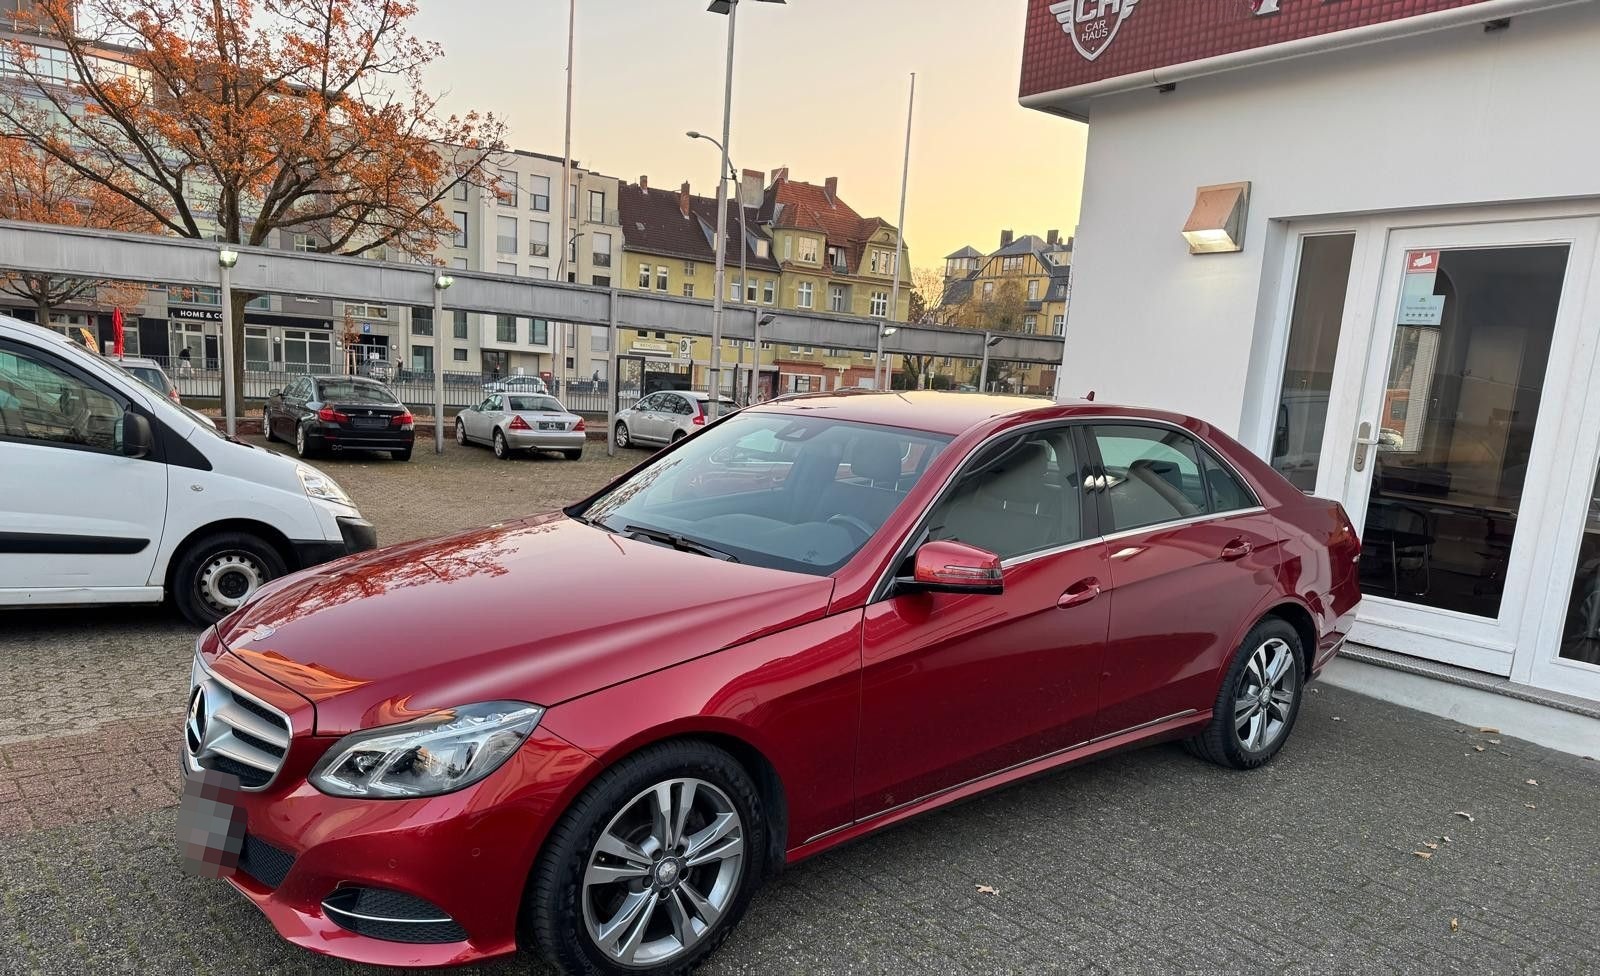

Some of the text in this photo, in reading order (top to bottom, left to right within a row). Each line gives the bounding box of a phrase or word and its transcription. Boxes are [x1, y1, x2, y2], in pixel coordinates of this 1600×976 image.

[1085, 20, 1106, 32] CAR
[1081, 28, 1108, 42] HAUS
[180, 310, 204, 318] HOME
